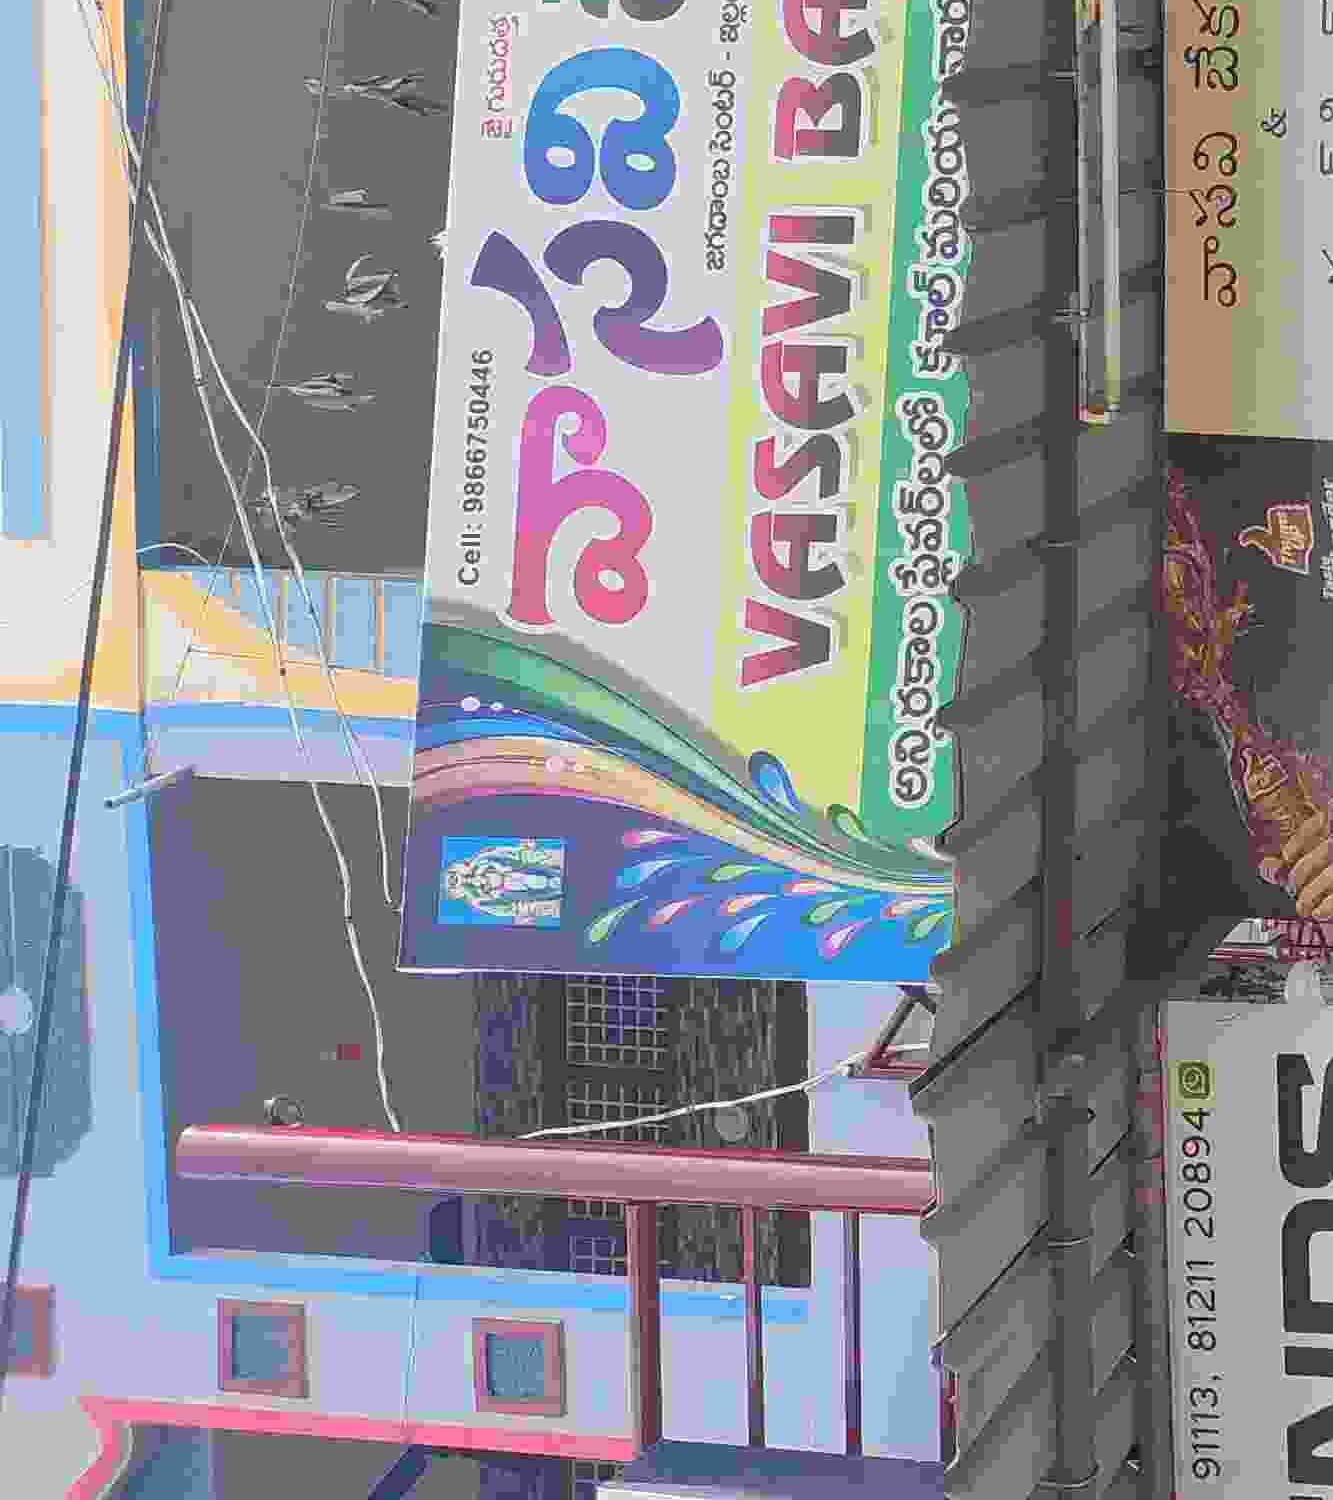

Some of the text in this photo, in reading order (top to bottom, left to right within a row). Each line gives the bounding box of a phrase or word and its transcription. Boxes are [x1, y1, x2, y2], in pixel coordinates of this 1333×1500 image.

[479, 118, 512, 139] జై
[708, 69, 735, 151] సెంటర్
[1259, 107, 1289, 139] &
[704, 159, 730, 271] జగదాంబ
[1187, 131, 1241, 308] వాసవి
[467, 46, 724, 626] వాసవి
[456, 348, 494, 587] Cell: 9866750446
[739, 207, 862, 688] VASAVI
[1179, 1108, 1224, 1479] 91113, 81211 20894
